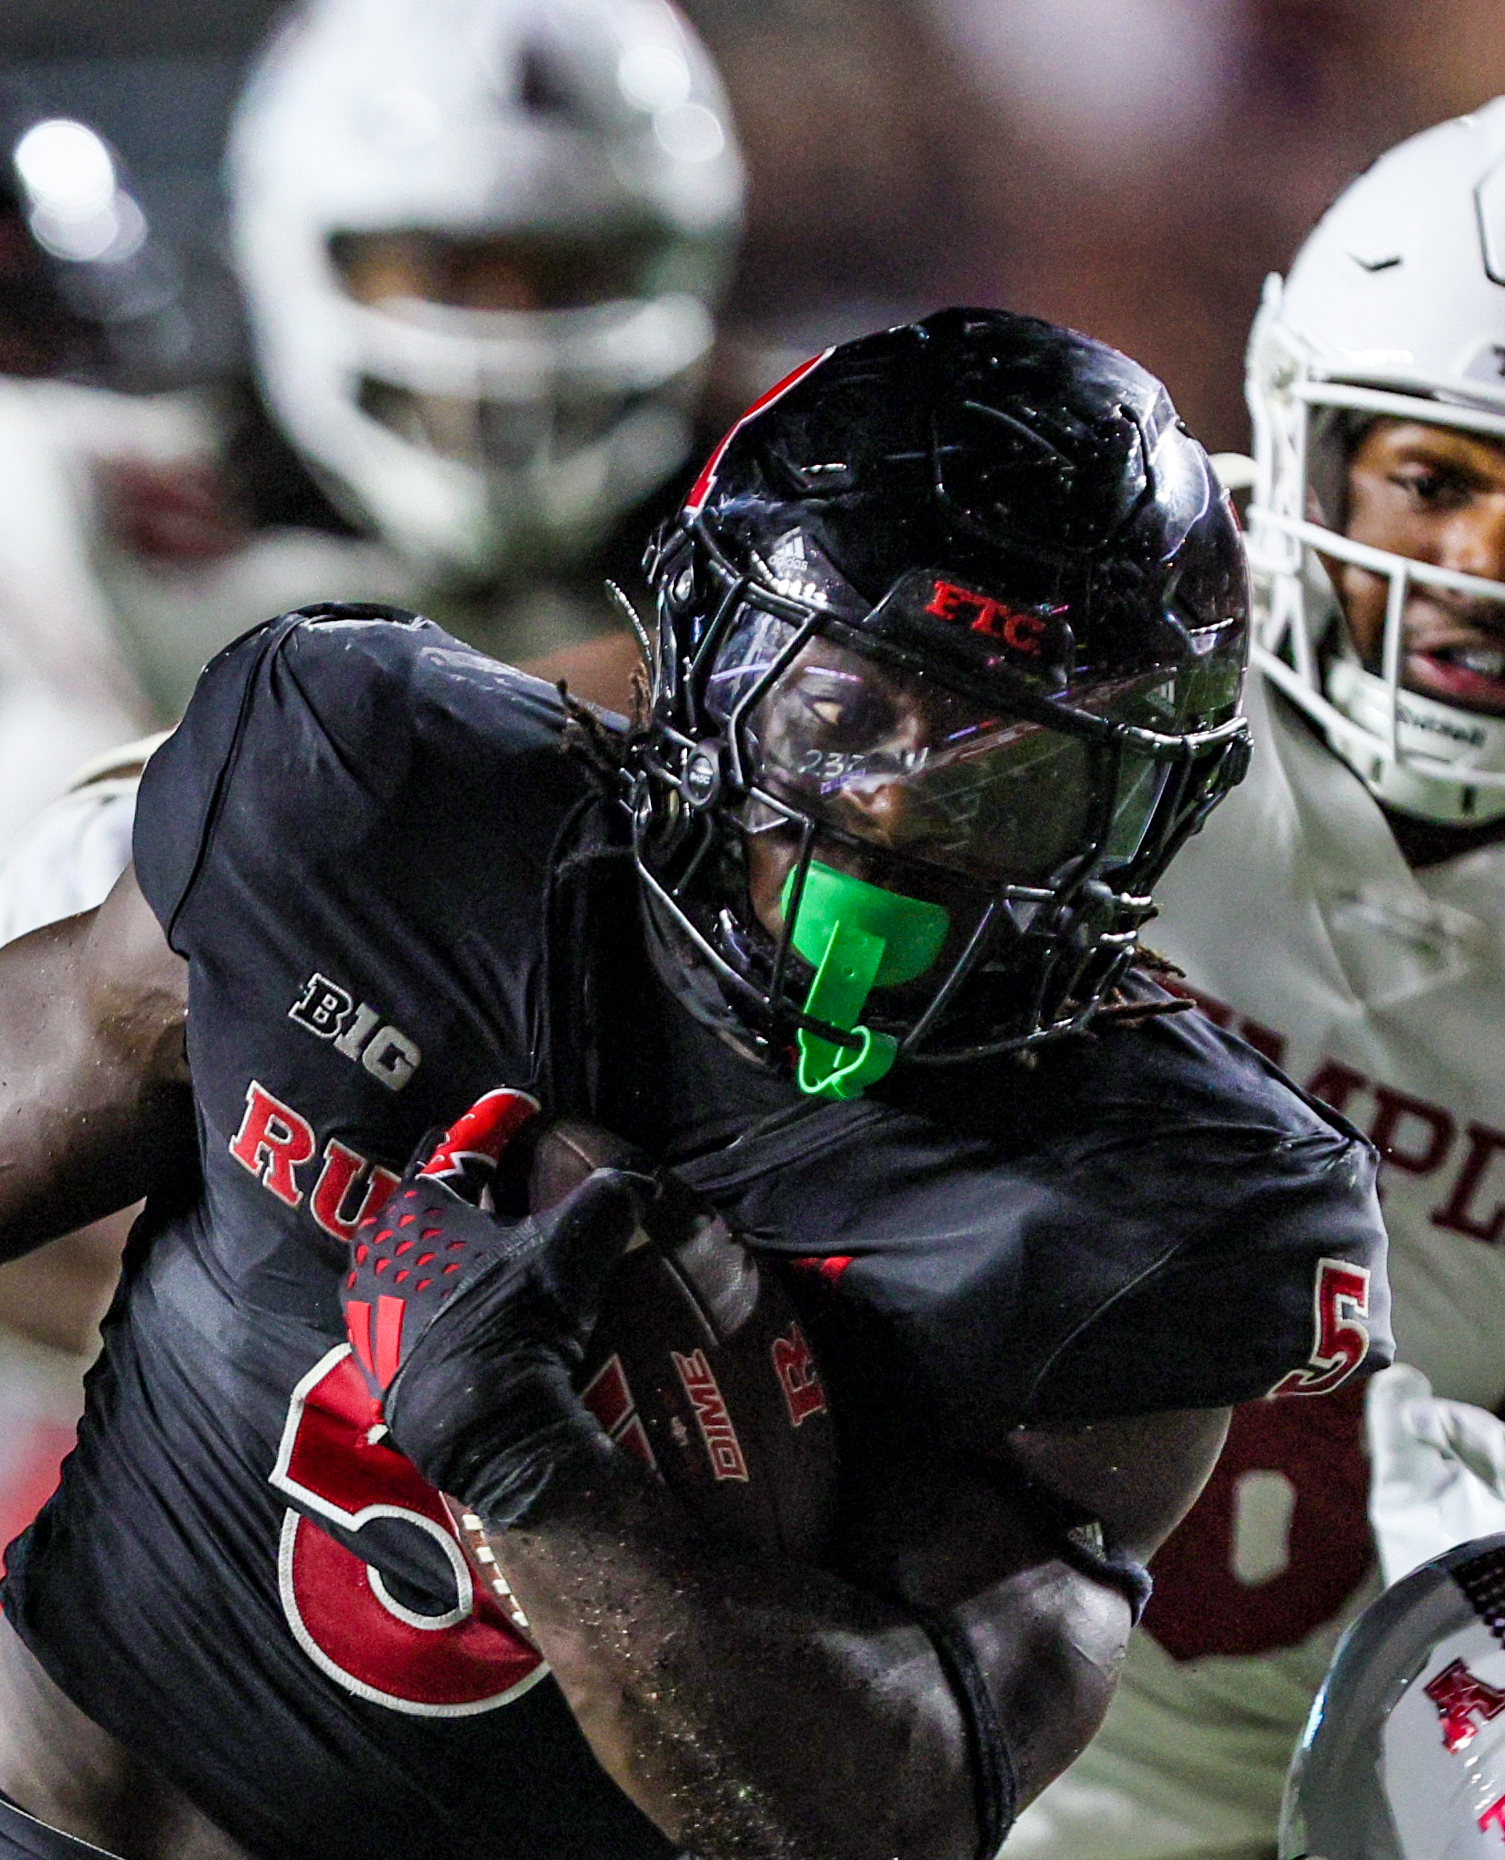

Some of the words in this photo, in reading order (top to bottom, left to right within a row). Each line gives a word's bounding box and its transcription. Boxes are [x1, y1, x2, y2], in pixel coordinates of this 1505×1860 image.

[924, 579, 1047, 656] FTC
[771, 1321, 828, 1428] R
[1266, 1257, 1372, 1402] 5
[670, 1348, 750, 1484] DIME
[268, 1342, 553, 1718] 5
